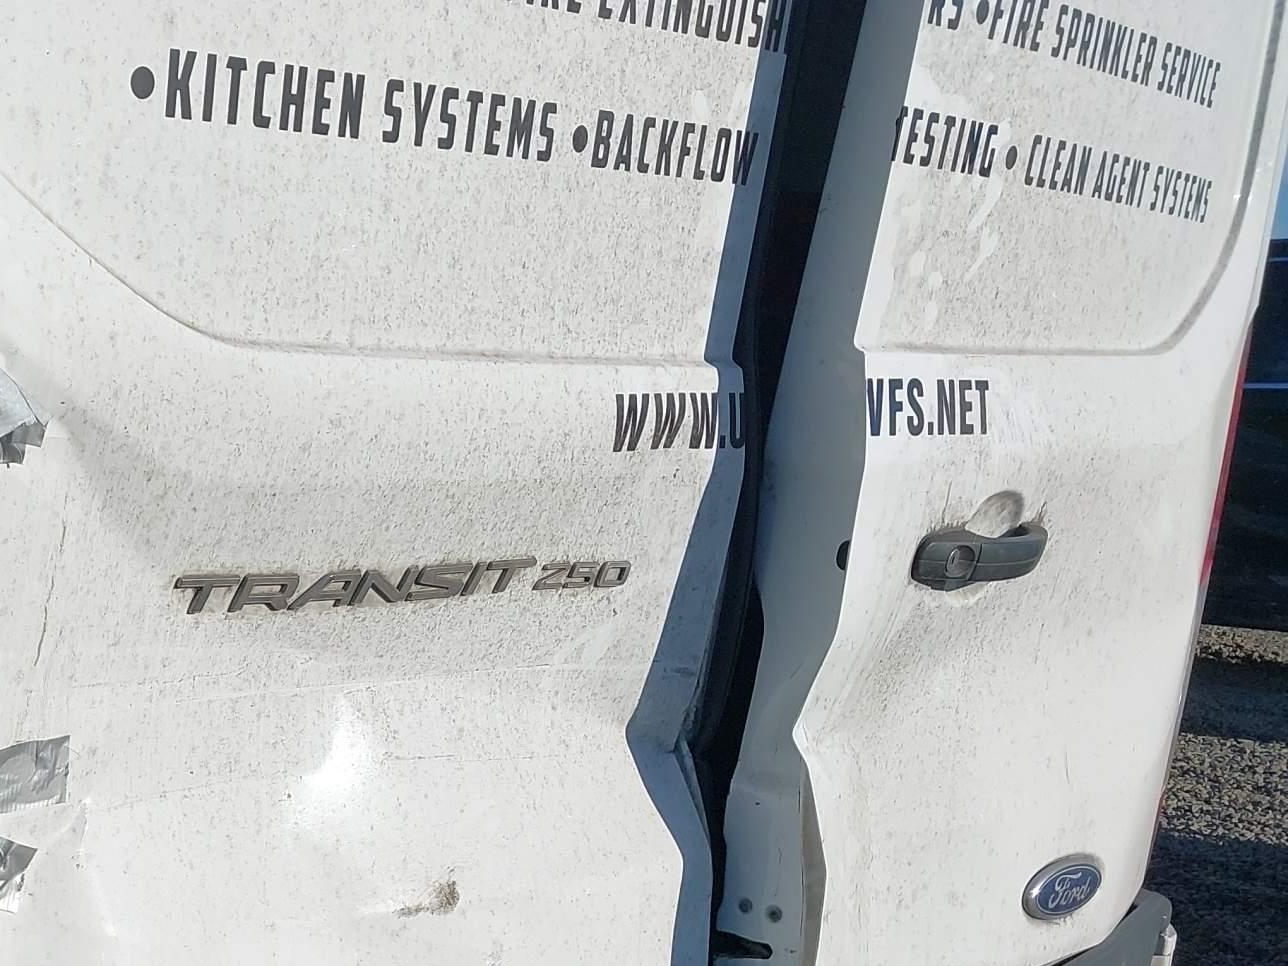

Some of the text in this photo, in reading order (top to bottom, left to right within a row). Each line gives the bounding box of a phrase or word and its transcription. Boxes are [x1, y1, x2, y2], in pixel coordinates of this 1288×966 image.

[988, 0, 1049, 52] FIRE
[1051, 4, 1158, 87] SPRINKLER
[1157, 42, 1222, 109] SERVICE
[165, 48, 760, 187] KITCHEN SYSTEMS BACKFLOW
[891, 105, 1213, 223] TESTING CLEAN AGENT SYSTEMS
[174, 556, 632, 615] TRANSIT 250
[1048, 872, 1091, 909] Ford
